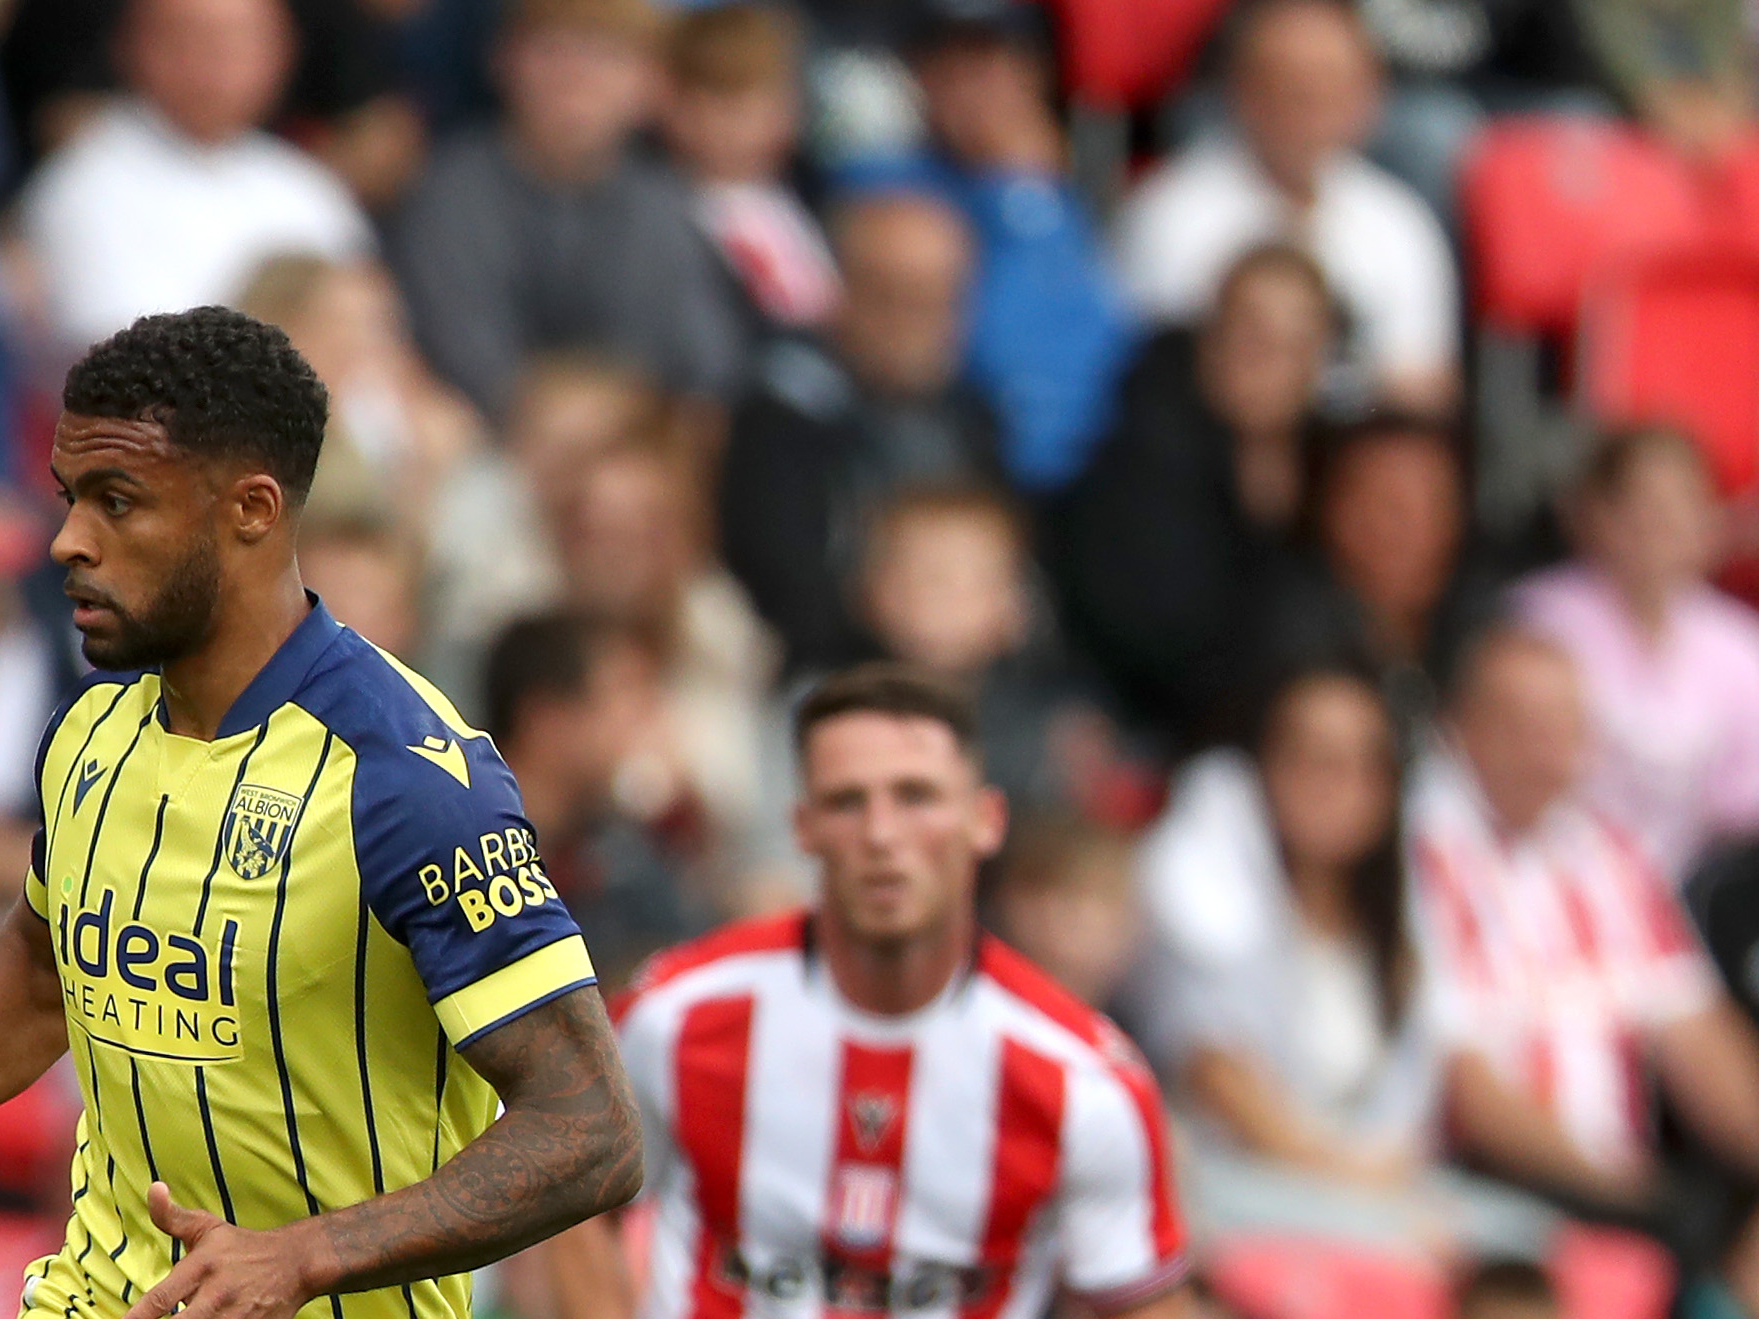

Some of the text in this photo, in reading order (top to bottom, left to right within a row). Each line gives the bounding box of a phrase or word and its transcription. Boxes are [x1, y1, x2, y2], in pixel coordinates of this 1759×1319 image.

[235, 796, 294, 822] ALBION
[418, 828, 540, 906] BARBE
[457, 863, 559, 933] BOSS
[60, 876, 239, 1006] ideal
[63, 975, 239, 1046] HEATING
